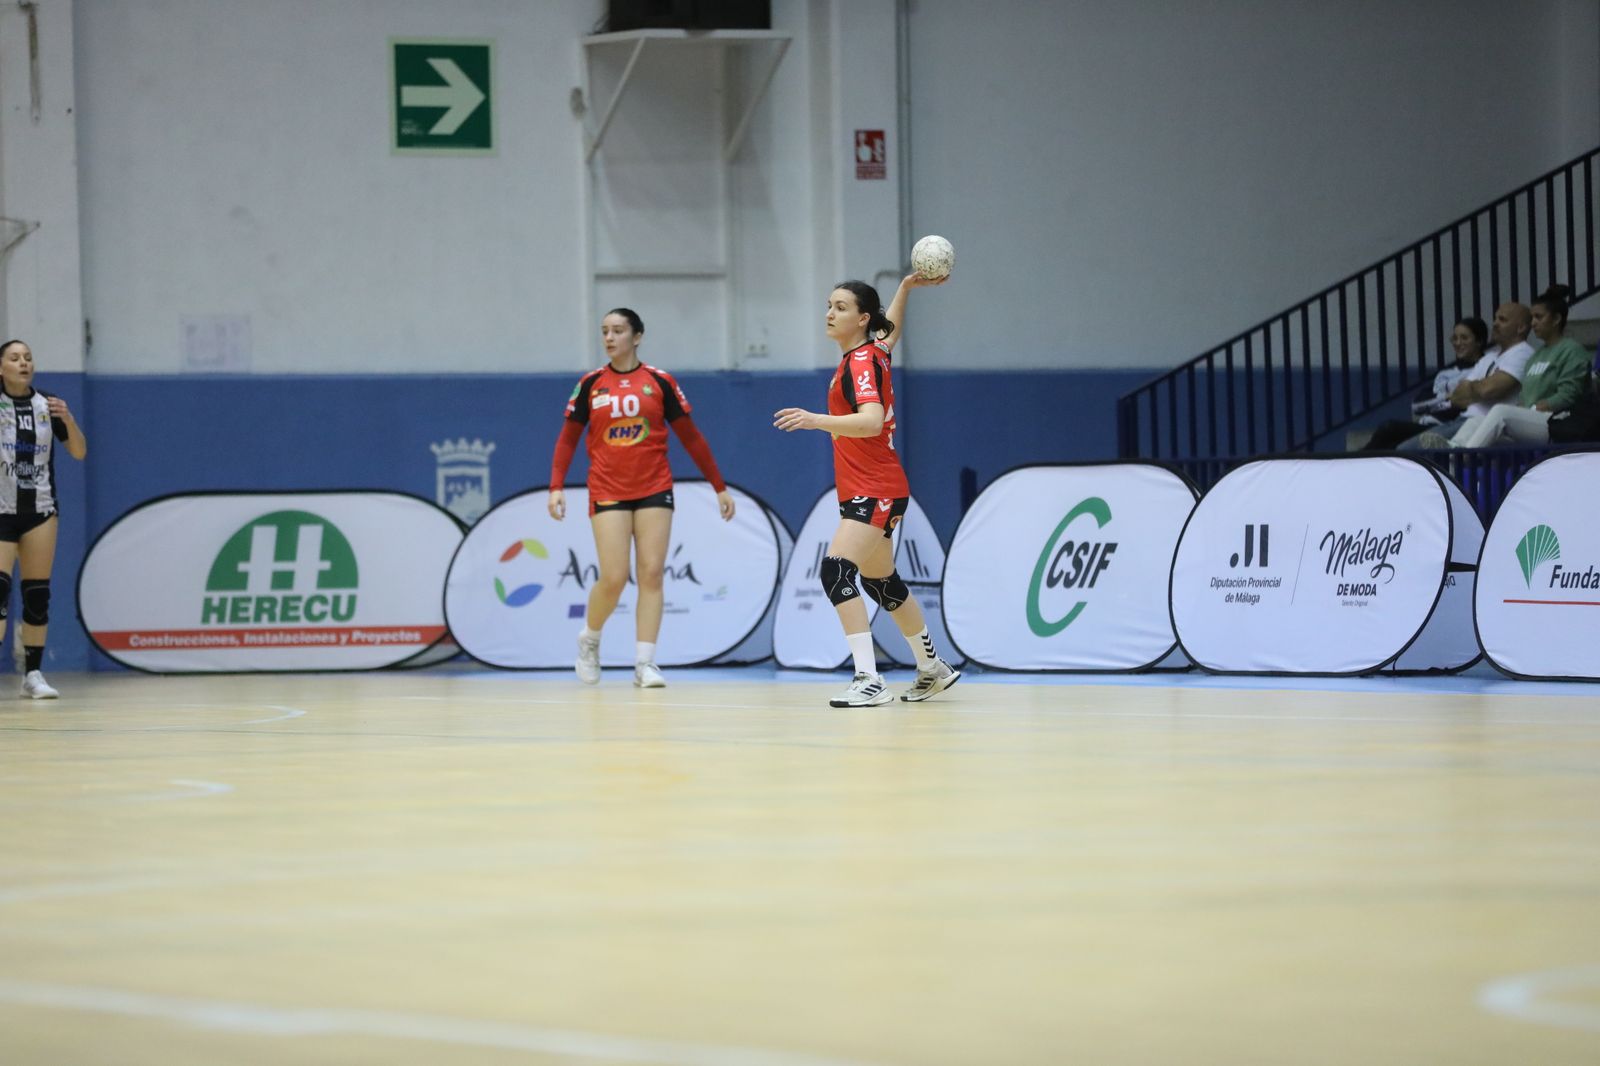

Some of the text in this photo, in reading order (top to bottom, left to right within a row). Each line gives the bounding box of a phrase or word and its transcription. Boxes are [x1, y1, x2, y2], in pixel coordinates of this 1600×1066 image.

[608, 394, 641, 418] 10
[18, 414, 33, 430] 10
[1046, 540, 1118, 589] CSIF
[1319, 527, 1404, 584] Málaga
[1210, 576, 1281, 590] Diputación Provincial
[1549, 564, 1600, 589] Funda
[1225, 592, 1260, 605] de Málaga
[1337, 583, 1377, 596] DE MODA
[201, 594, 357, 624] HERECU
[129, 630, 421, 647] Construcciones, Instalaciones y Proyectos
